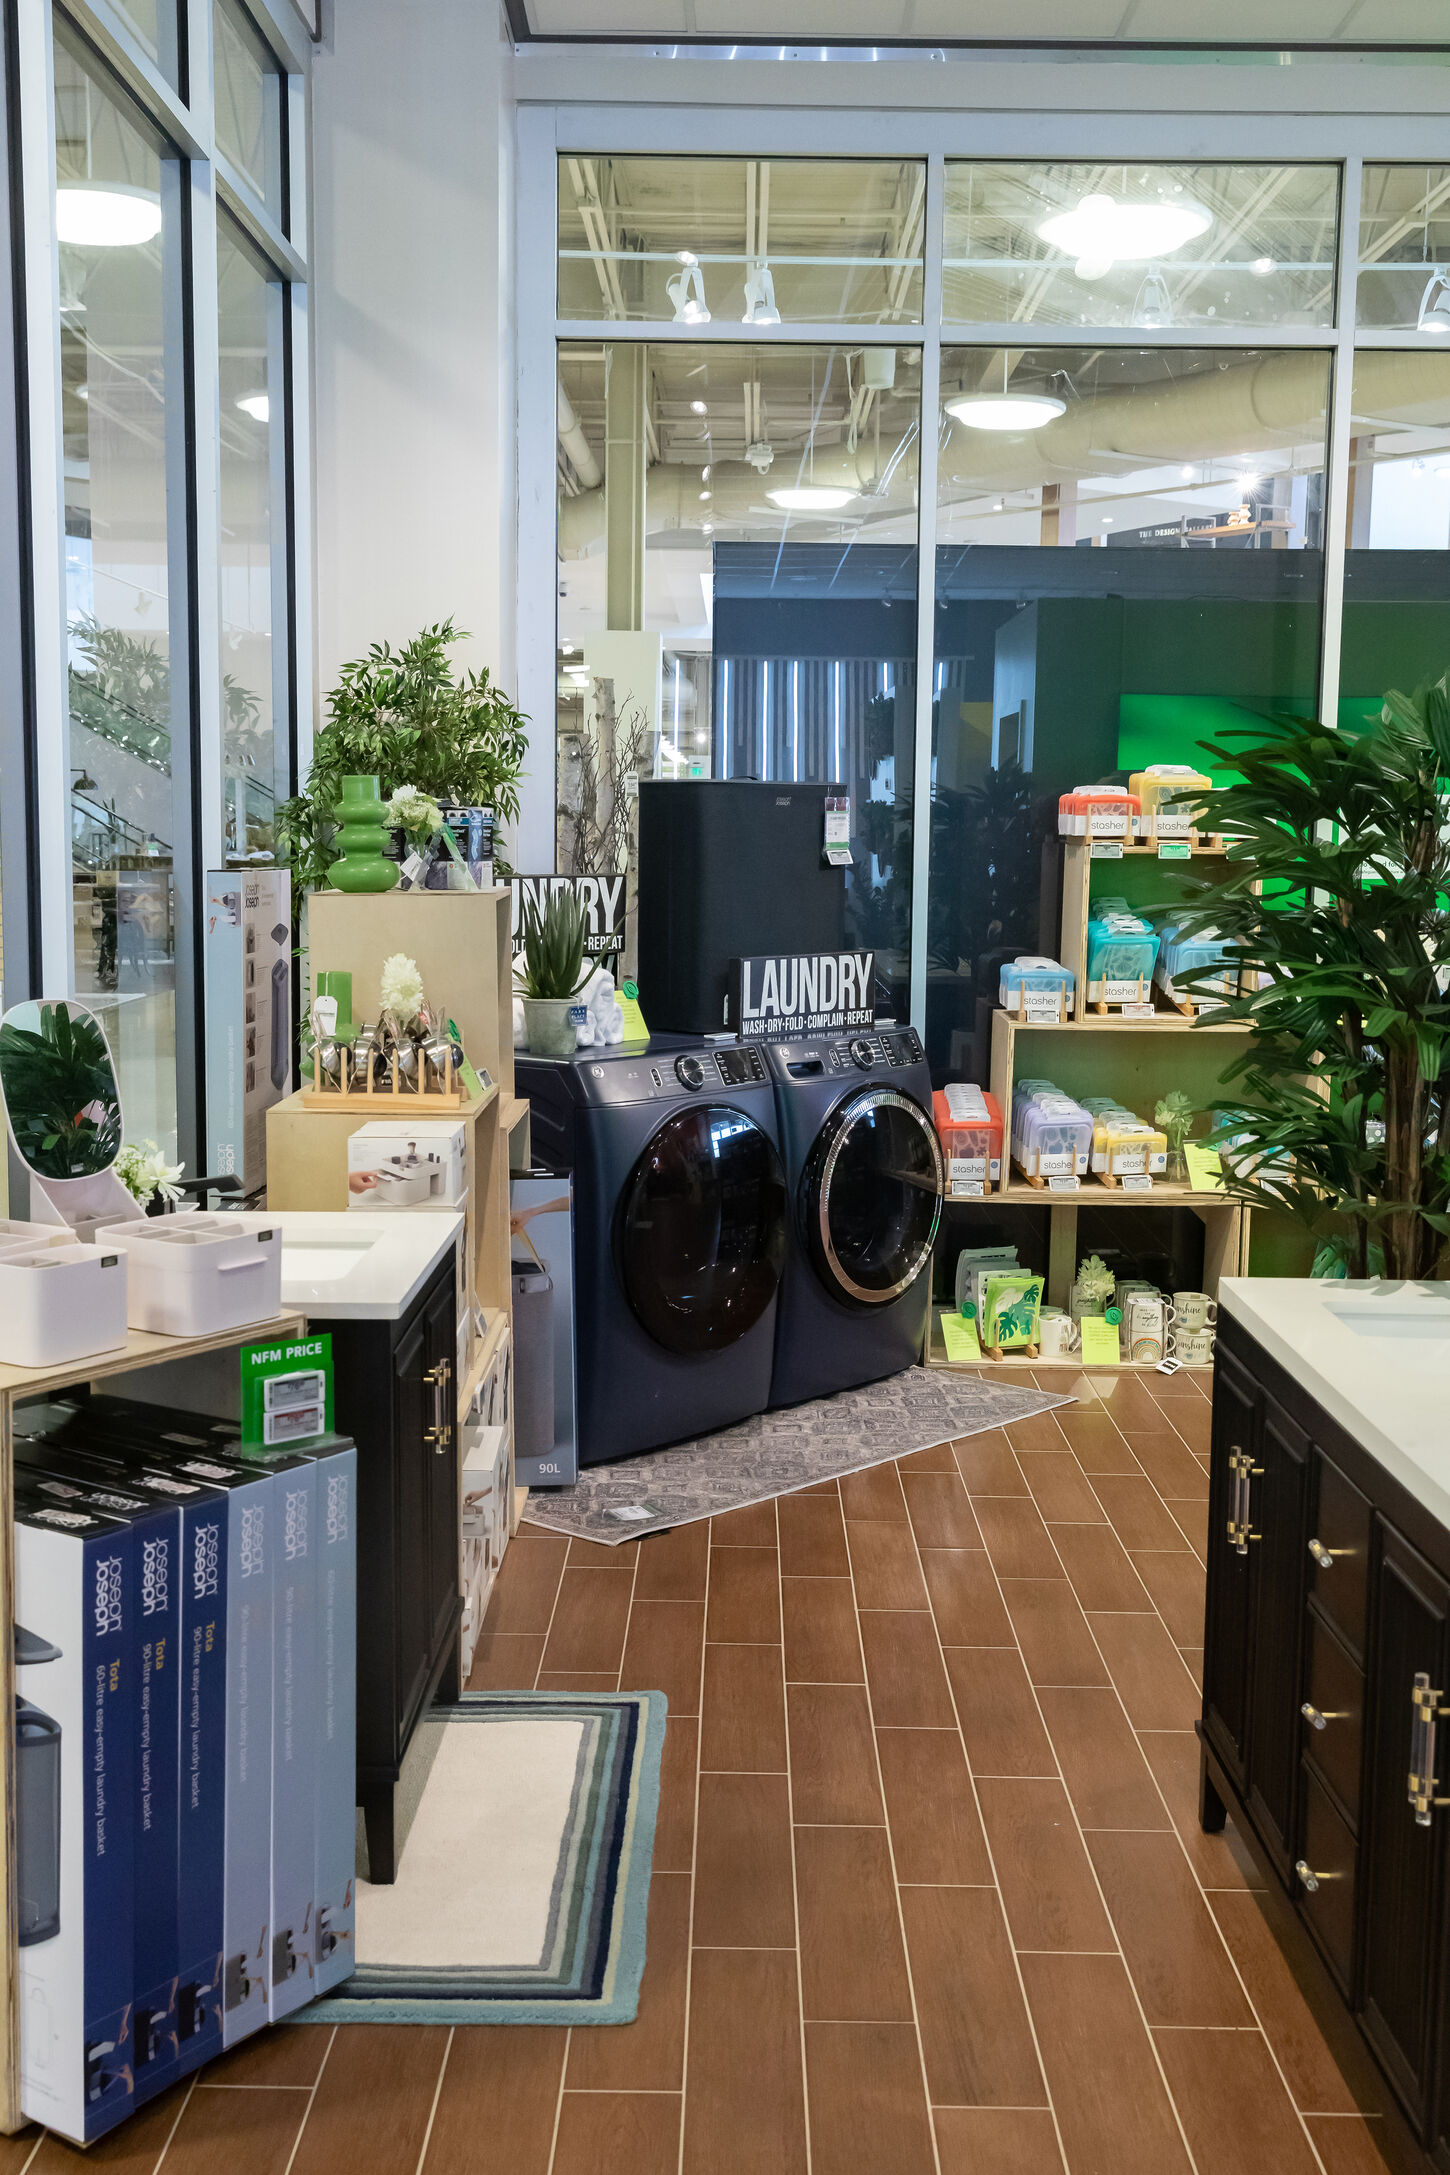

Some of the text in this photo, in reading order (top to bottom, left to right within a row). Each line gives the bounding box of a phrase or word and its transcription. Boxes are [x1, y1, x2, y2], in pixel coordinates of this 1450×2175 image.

[1139, 530, 1152, 538] THE
[1091, 820, 1124, 830] stasher
[1157, 821, 1190, 831] stasher
[743, 953, 873, 1018] LAUNDRY
[1105, 986, 1136, 996] stasher
[1024, 996, 1056, 1006] stasher
[953, 1164, 986, 1174] stasher
[1043, 1160, 1073, 1170] stashe
[251, 1342, 323, 1365] NFM PRICE
[539, 1463, 561, 1474] 90L
[205, 1620, 215, 1652] Tota
[155, 1637, 166, 1671] Tota
[109, 1658, 120, 1692] Tota
[190, 1626, 202, 1809] 90-litre easy-empty laundry basket
[140, 1643, 152, 1832] 90-litre easy-empty laundry basket
[94, 1665, 106, 1856] 60-litre easy-empty laundry basket
